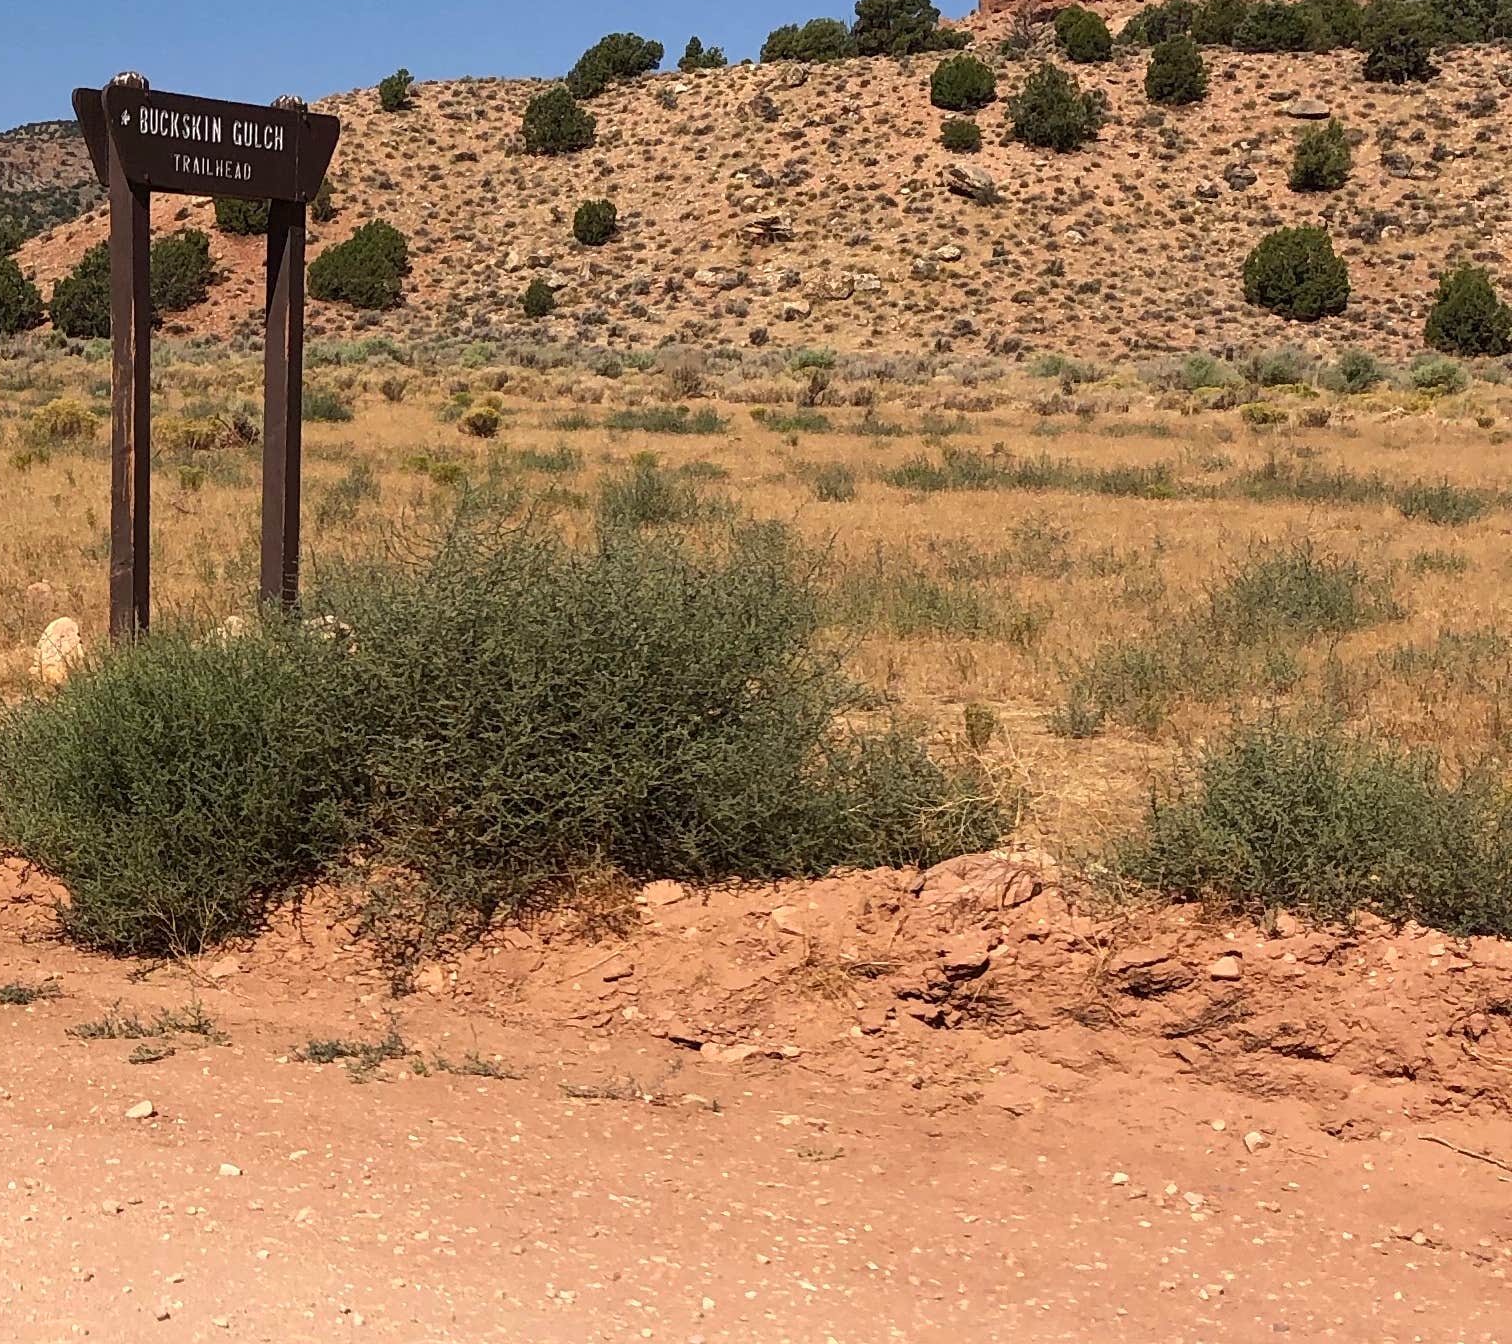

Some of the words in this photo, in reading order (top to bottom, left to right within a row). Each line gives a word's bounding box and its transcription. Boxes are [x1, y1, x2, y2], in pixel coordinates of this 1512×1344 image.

[139, 105, 221, 143] BUCKSKIN
[233, 119, 284, 151] GULCH
[173, 153, 252, 181] TRAILHEAD
